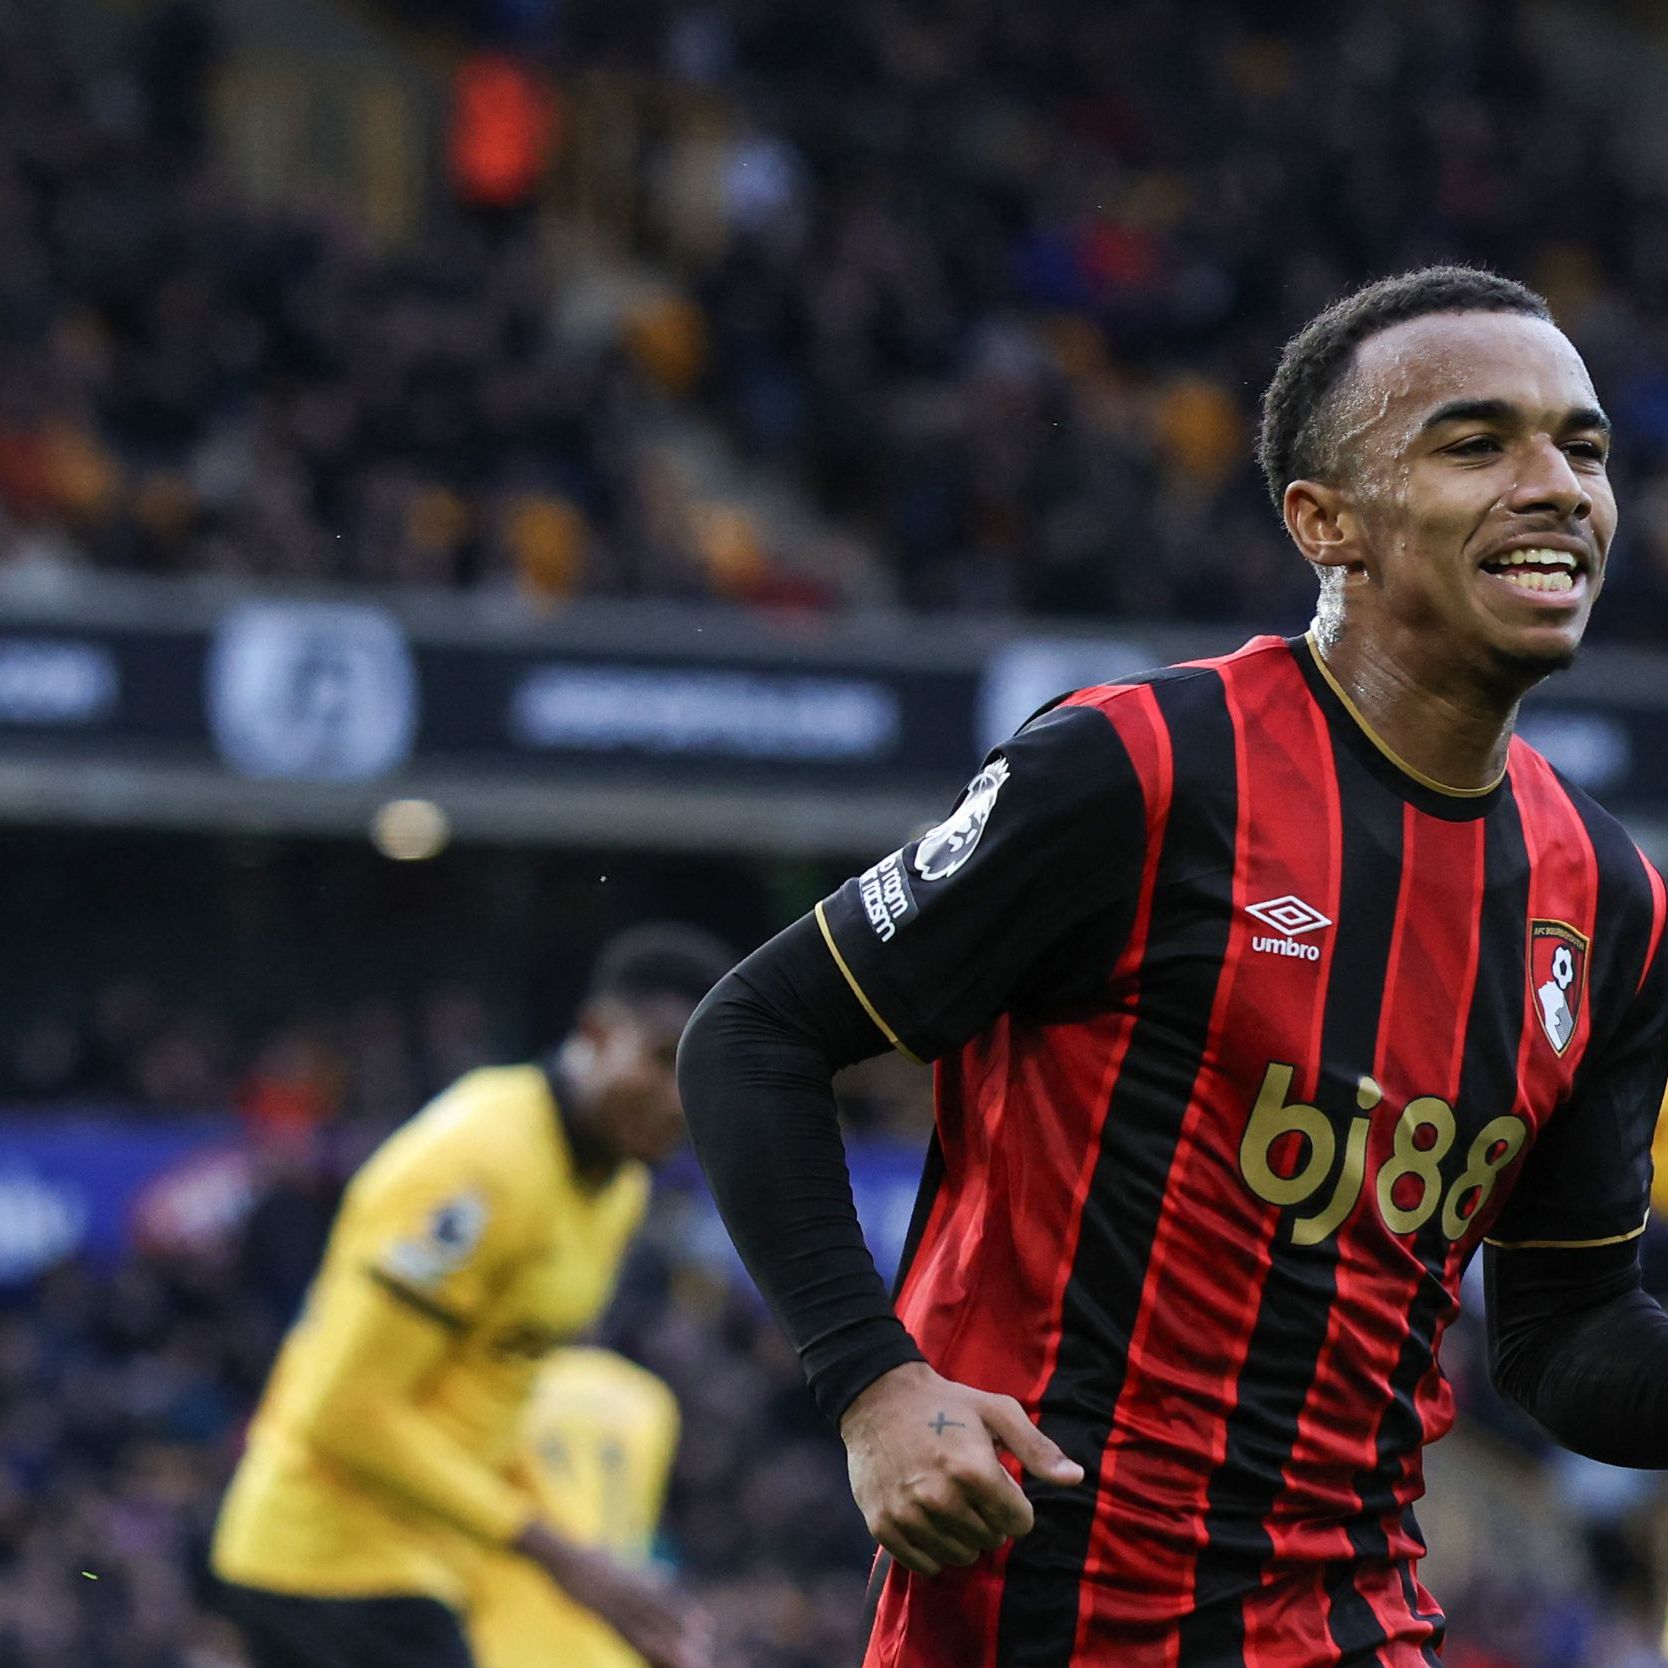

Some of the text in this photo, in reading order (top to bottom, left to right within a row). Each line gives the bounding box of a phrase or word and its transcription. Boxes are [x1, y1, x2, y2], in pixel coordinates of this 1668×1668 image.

[1533, 927, 1546, 936] AFC
[1251, 935, 1320, 962] umbro
[1238, 1061, 1527, 1247] bj88
